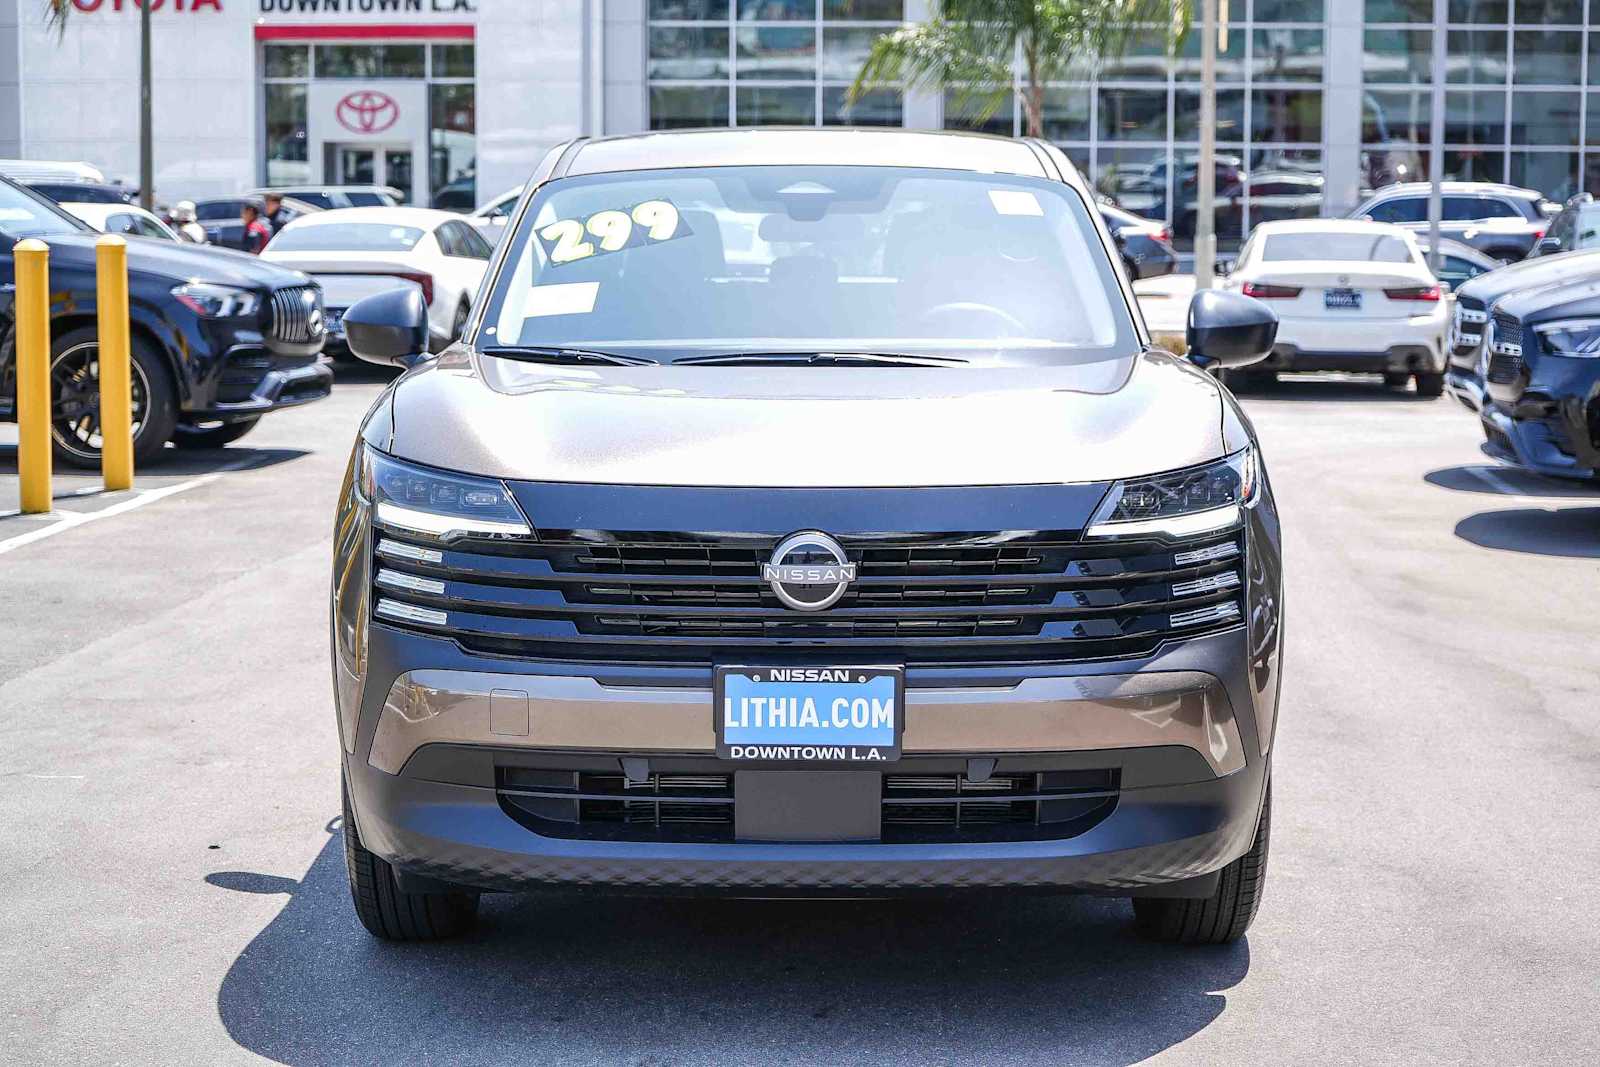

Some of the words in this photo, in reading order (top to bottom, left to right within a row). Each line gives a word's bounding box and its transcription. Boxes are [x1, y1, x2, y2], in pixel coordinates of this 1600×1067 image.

[540, 199, 679, 264] 299
[765, 566, 855, 582] NISSAN
[770, 669, 850, 682] NISSAN
[724, 697, 894, 729] LITHIA.COM
[730, 746, 846, 760] DOWNTOWN
[851, 747, 887, 760] L.A.
